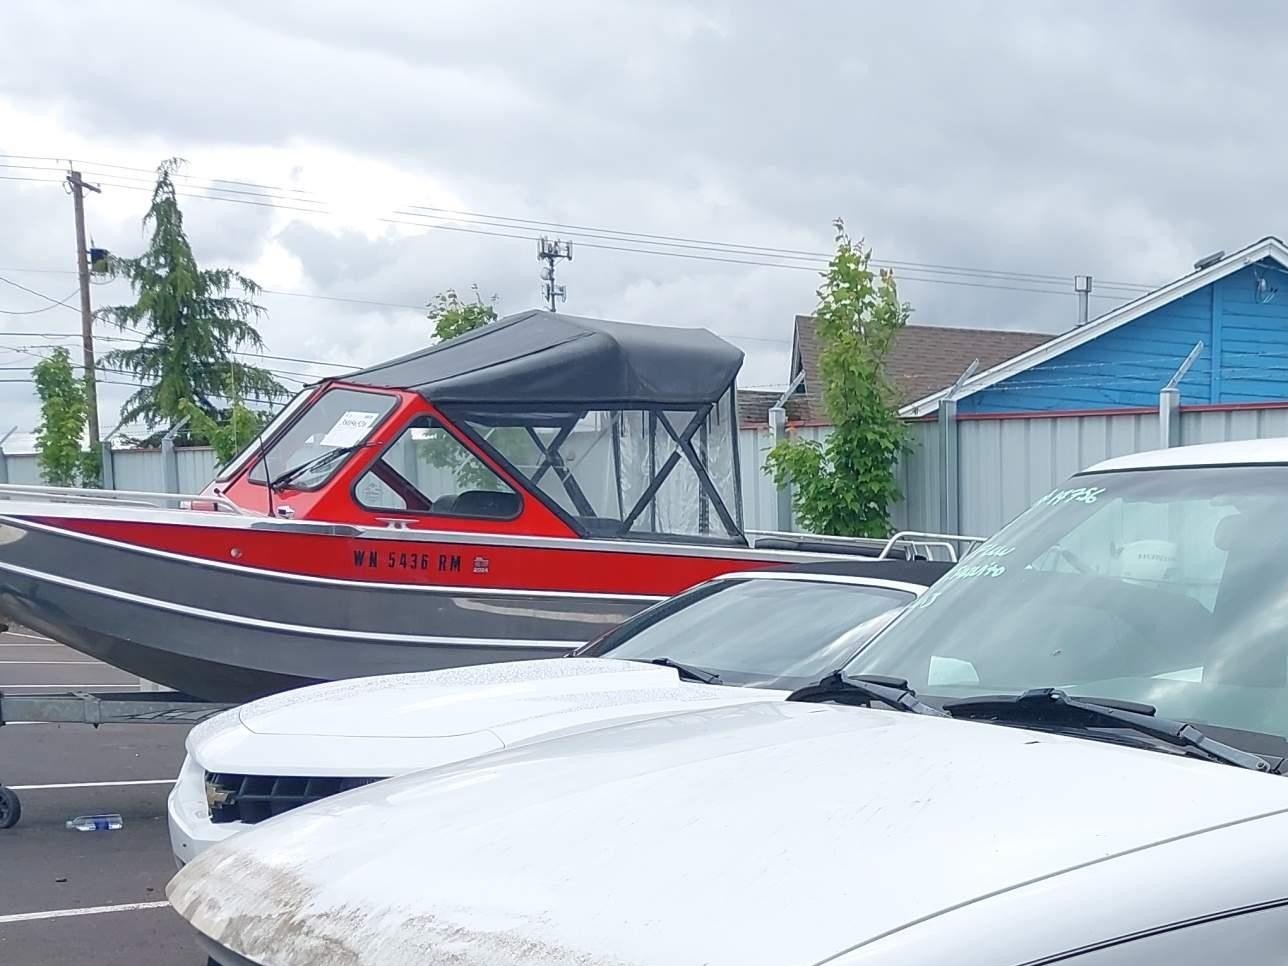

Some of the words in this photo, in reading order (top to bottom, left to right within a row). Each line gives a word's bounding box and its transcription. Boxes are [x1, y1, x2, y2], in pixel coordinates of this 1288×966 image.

[354, 551, 378, 568] WN
[388, 552, 430, 570] 5436
[438, 554, 462, 572] RM
